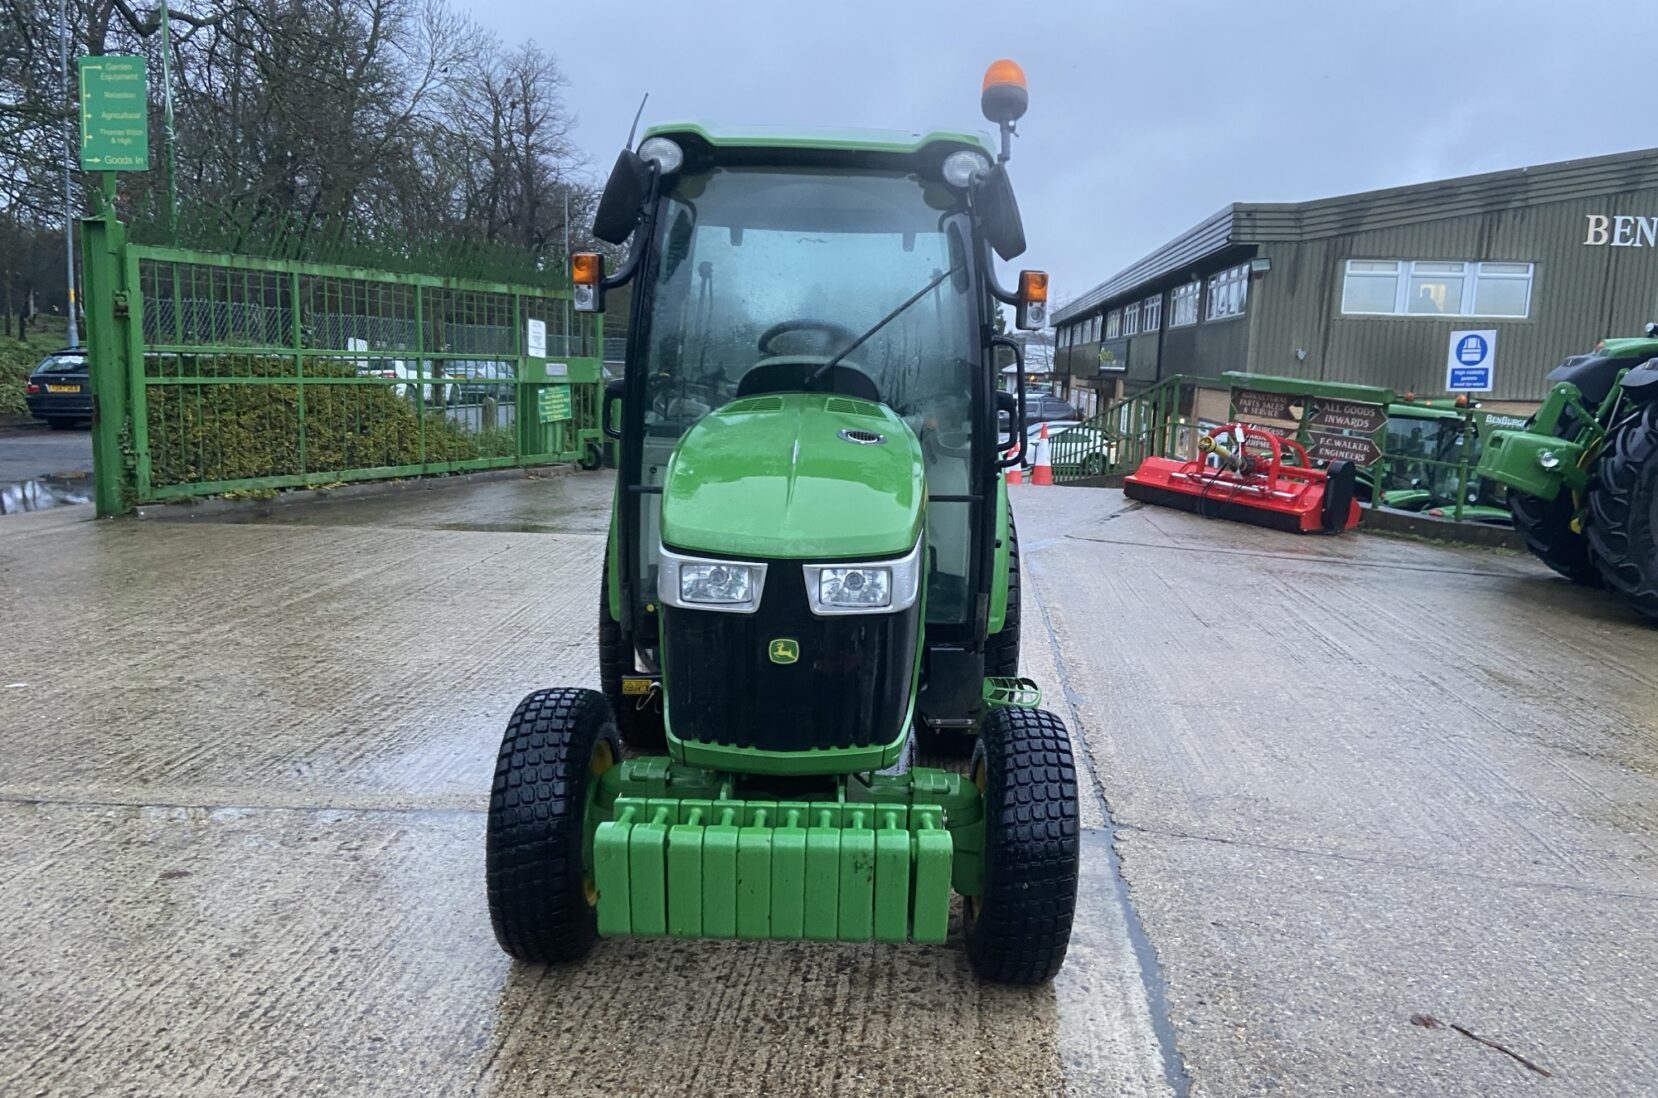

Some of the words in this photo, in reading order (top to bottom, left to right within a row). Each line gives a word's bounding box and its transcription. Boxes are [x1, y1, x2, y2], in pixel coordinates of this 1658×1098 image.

[104, 155, 133, 165] Goods
[135, 155, 144, 165] In
[1583, 214, 1658, 248] BEN
[1240, 398, 1260, 408] PARTS
[1261, 401, 1285, 412] SALES
[1323, 403, 1342, 413] ALL
[1344, 406, 1375, 417] GOODS
[1325, 415, 1369, 428] INWARDS
[1320, 448, 1366, 462] ENGINEERS
